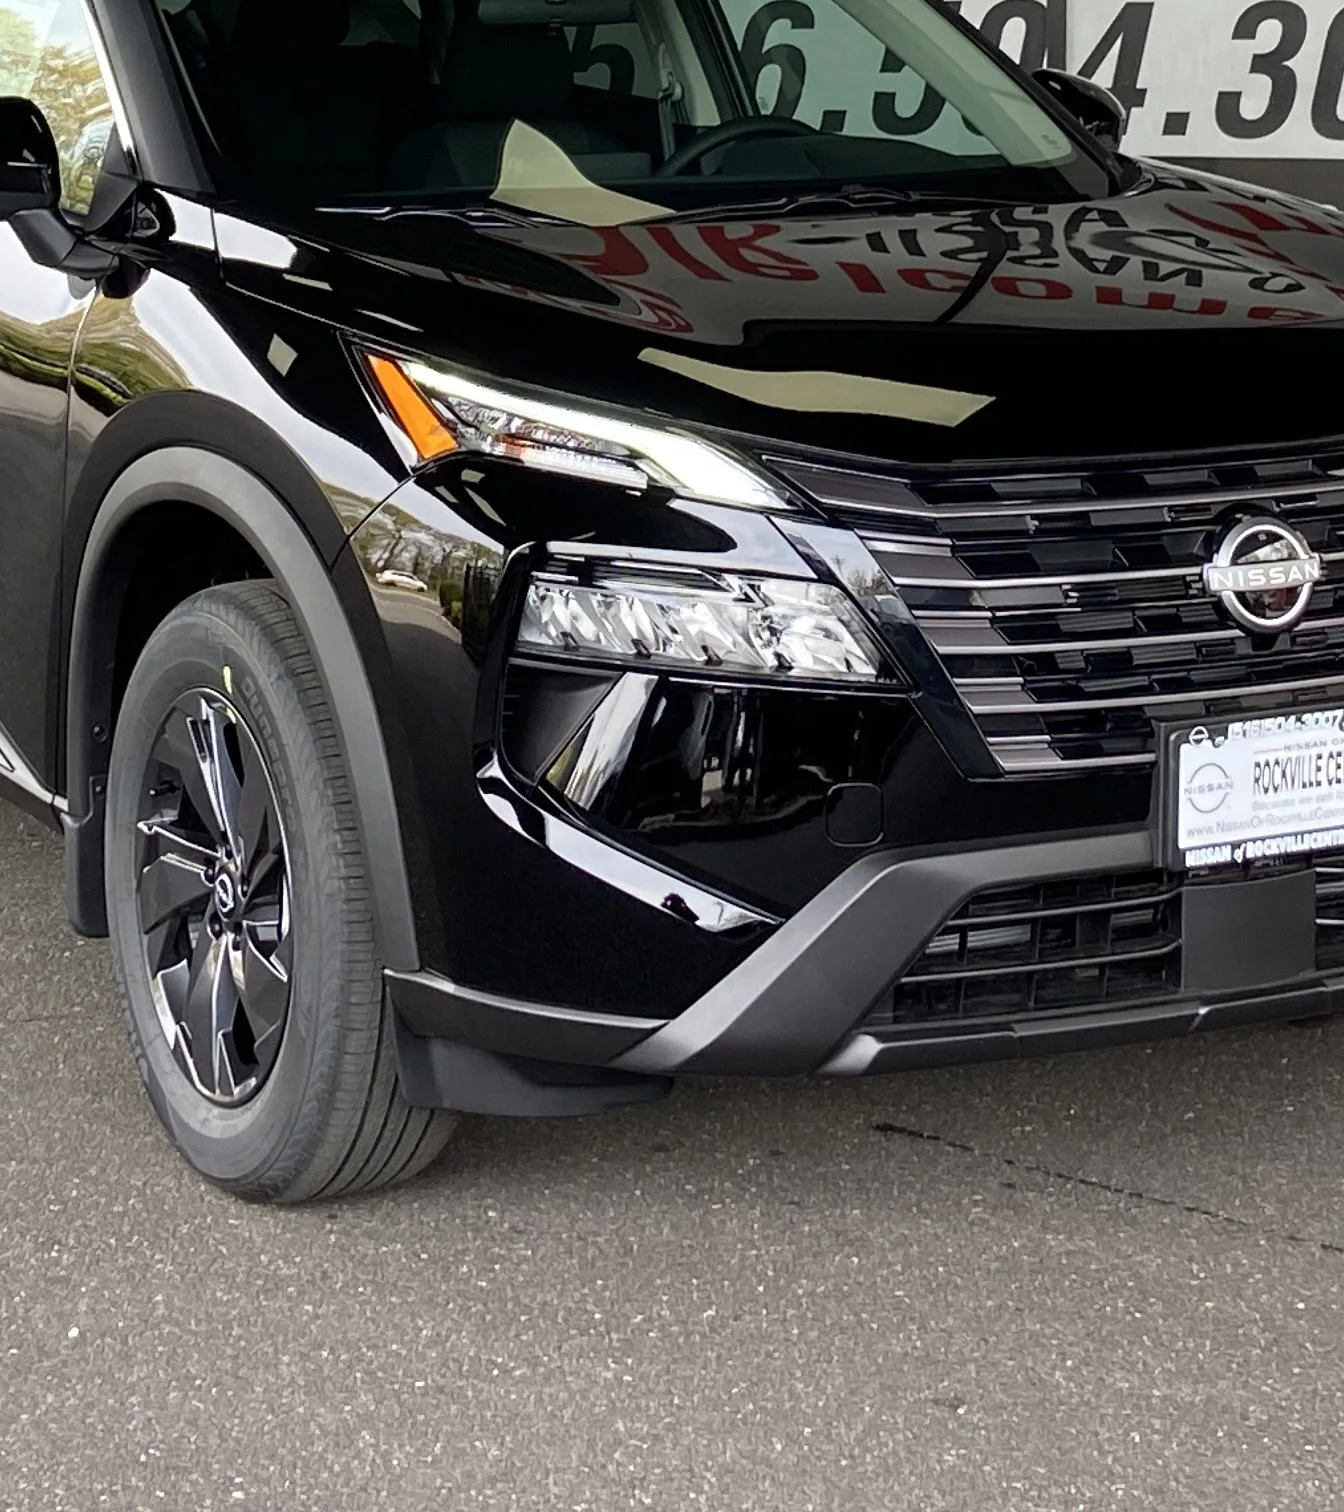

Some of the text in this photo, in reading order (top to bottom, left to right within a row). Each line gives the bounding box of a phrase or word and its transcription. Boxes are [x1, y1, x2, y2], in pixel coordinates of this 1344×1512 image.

[1213, 562, 1318, 588] NISSAN
[1283, 739, 1327, 752] NISSAN
[1253, 753, 1323, 795] ROCKVILLE
[1184, 780, 1233, 796] NISSAN
[1185, 844, 1232, 867] NISSAN
